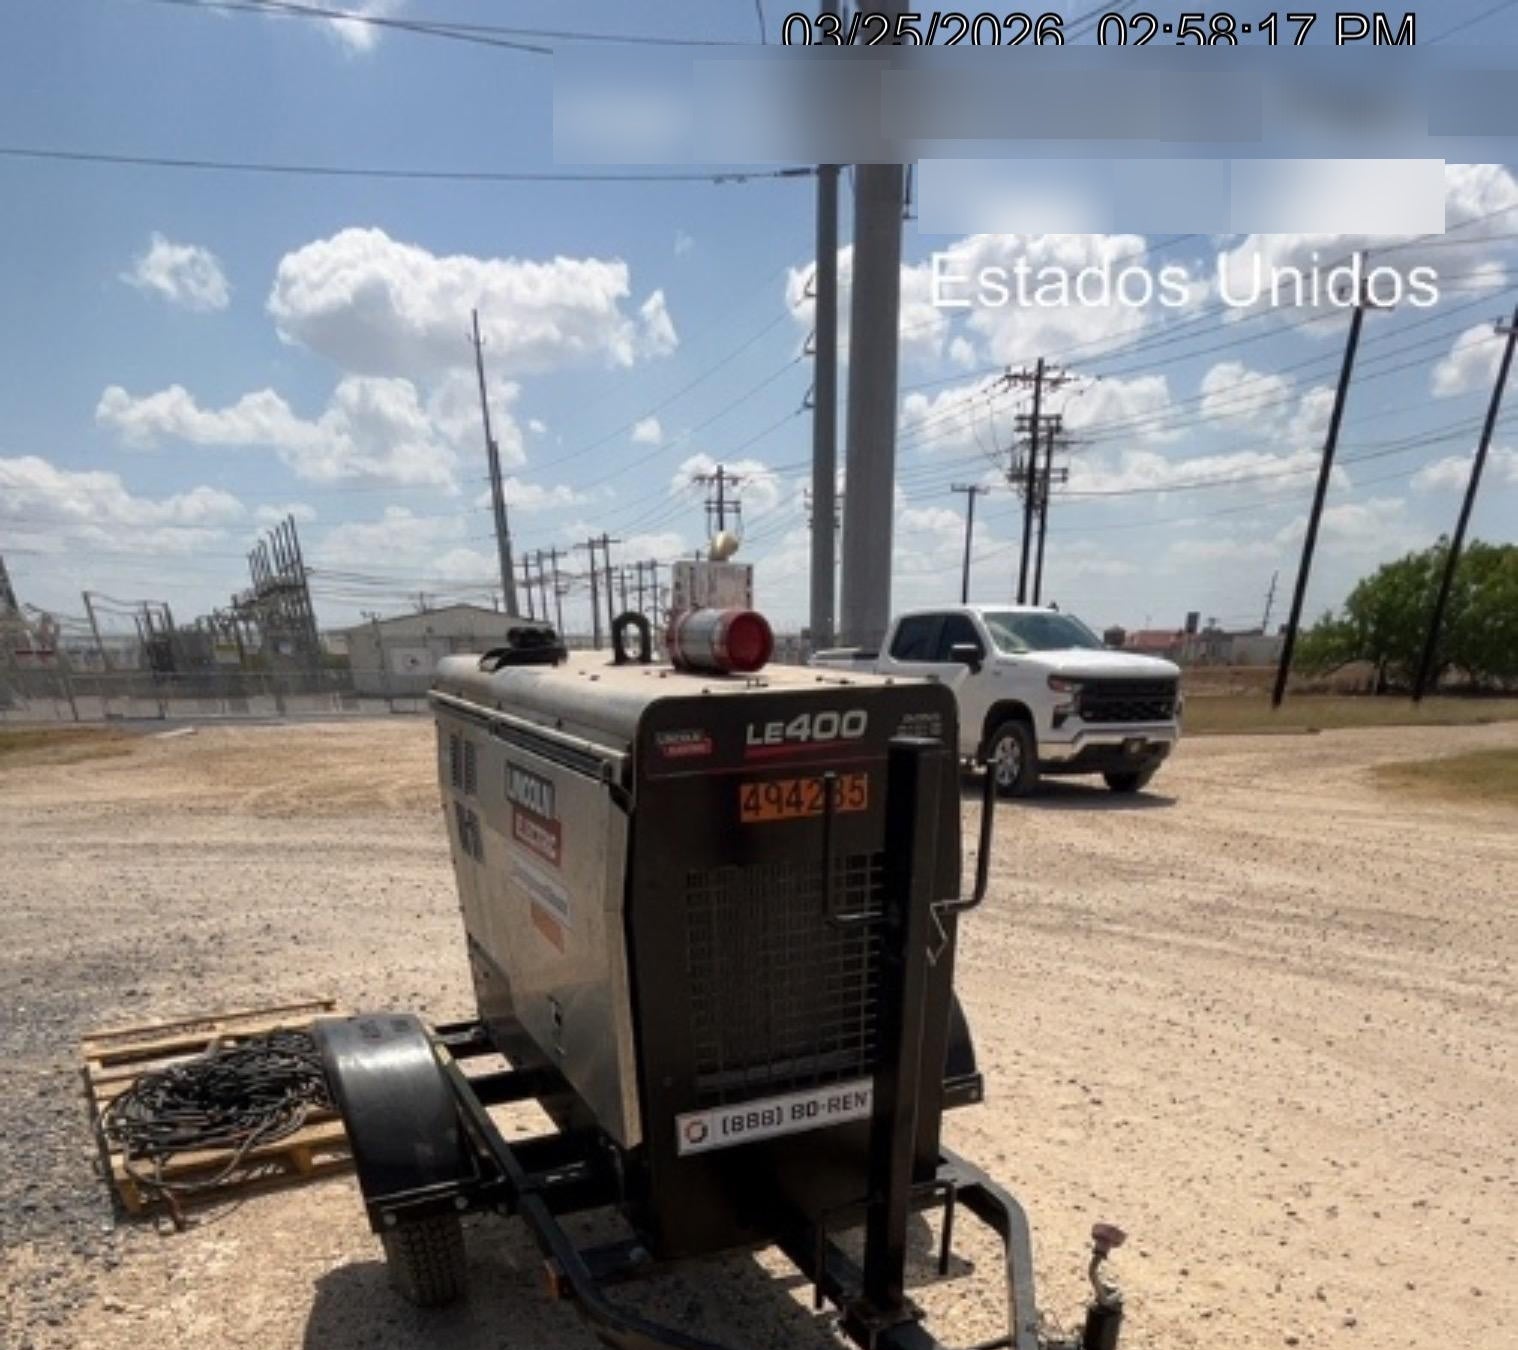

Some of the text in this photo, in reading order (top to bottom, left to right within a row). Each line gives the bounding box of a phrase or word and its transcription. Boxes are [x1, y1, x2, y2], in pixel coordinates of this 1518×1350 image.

[745, 709, 869, 746] LE400
[721, 1088, 873, 1136] (888) 80-REN
